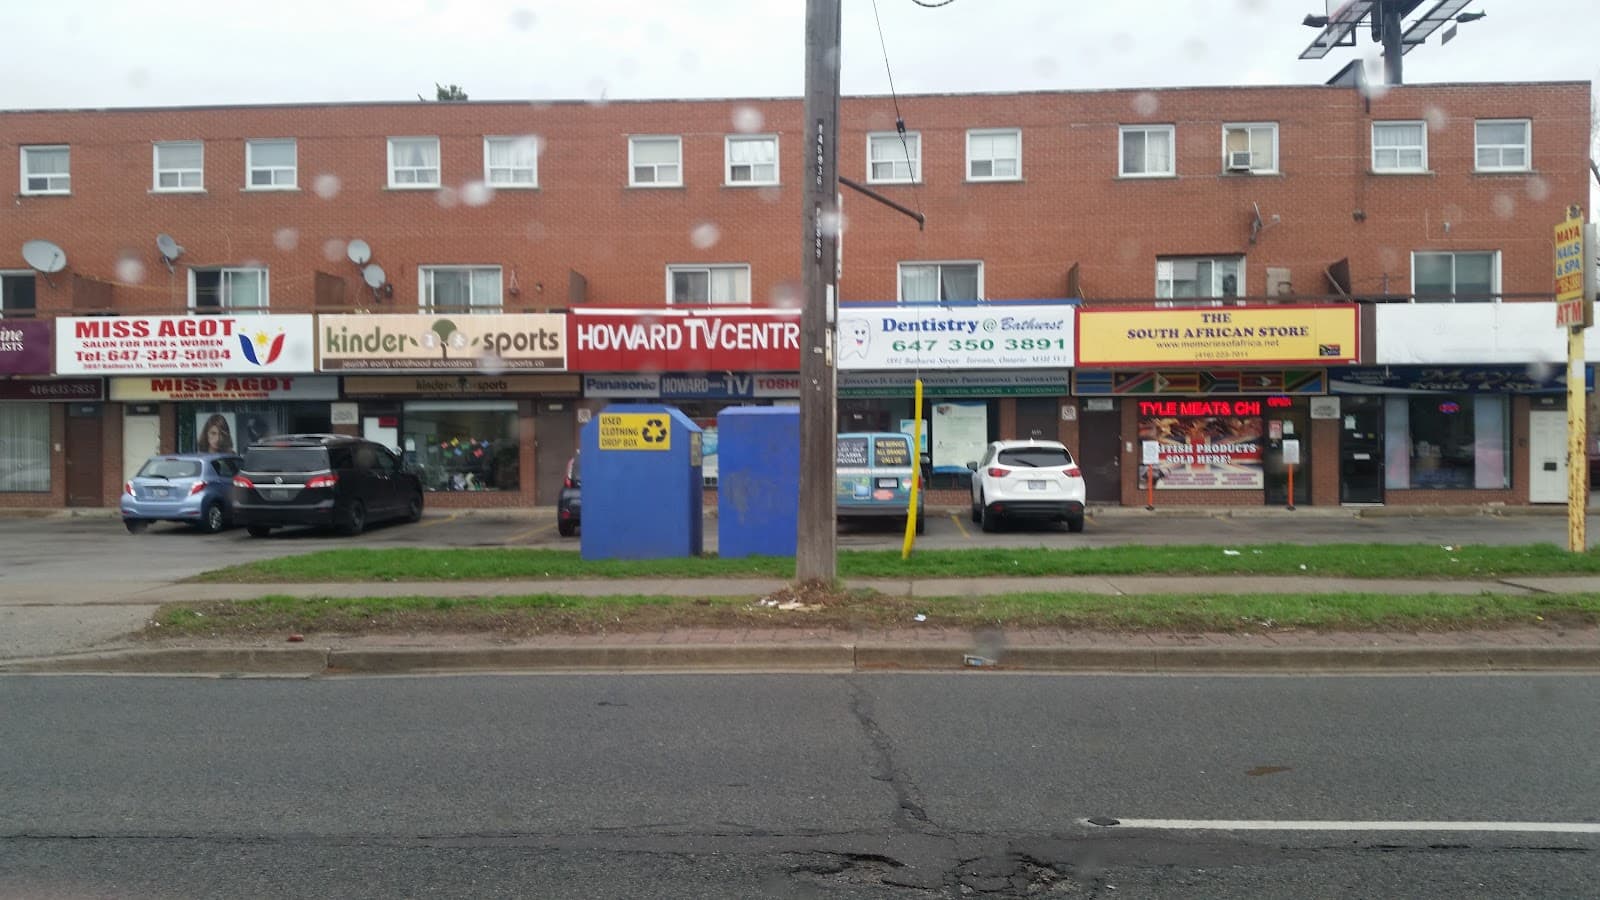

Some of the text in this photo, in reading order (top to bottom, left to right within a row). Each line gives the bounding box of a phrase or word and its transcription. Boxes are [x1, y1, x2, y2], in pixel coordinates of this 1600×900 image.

[1557, 225, 1580, 243] MAYA
[1564, 258, 1580, 274] SPA
[1201, 313, 1232, 323] THE
[1557, 301, 1581, 324] ATM
[75, 319, 236, 338] MISS AGOT
[882, 317, 1064, 334] Dentistry @ Bathurst
[1127, 326, 1309, 338] SOUTH AFRICAN STORE
[577, 318, 800, 350] HOWARD TV CENTR
[326, 326, 559, 358] kinder sports
[892, 338, 1065, 351] 647 350 3891
[151, 377, 294, 391] MISS AGOT
[585, 377, 657, 391] Panasonic
[662, 376, 750, 395] HOWARD TV
[757, 378, 800, 390] TOSHI
[602, 416, 622, 425] USED
[601, 427, 639, 437] CLOTHING
[601, 438, 639, 447] DROP BOX
[1195, 442, 1257, 454] PRODUCTS
[1165, 454, 1232, 465] SOLD HERE!
